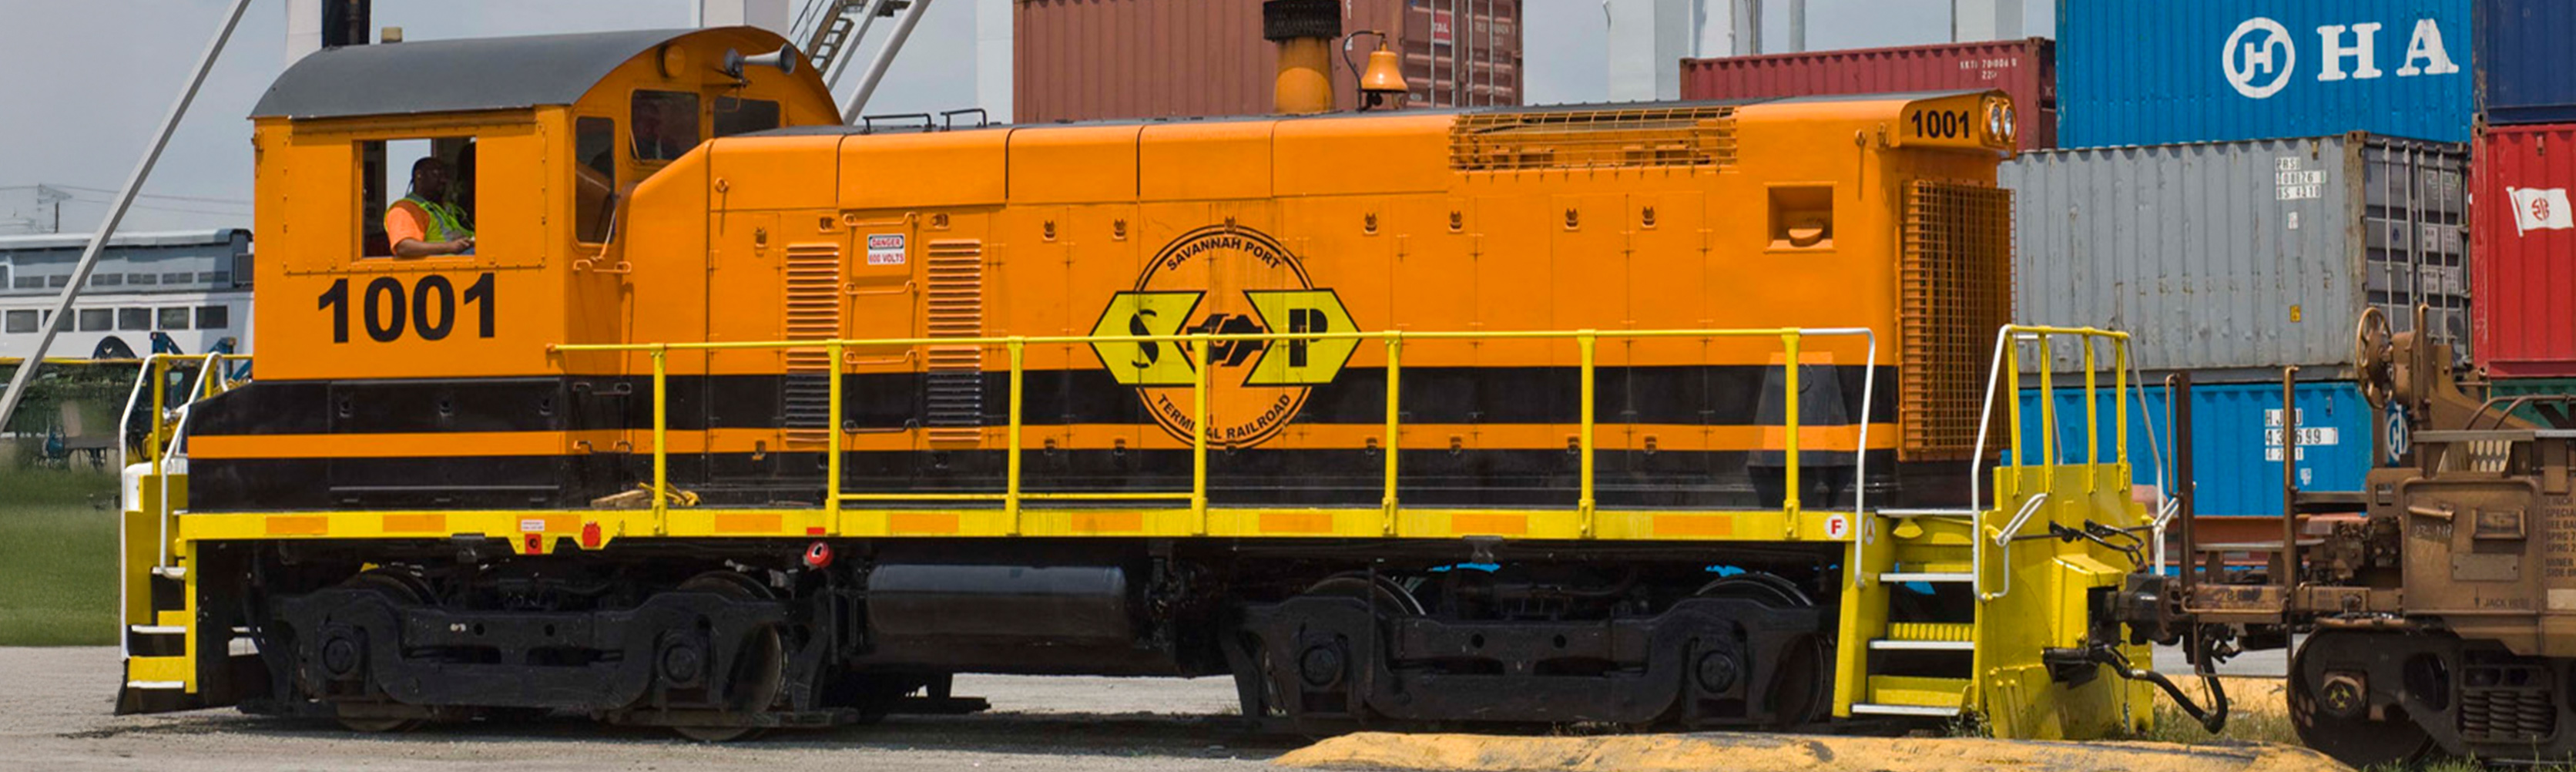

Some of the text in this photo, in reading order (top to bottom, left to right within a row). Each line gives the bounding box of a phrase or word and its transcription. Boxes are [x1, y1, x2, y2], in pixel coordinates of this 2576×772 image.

[1911, 109, 1970, 139] 1001
[871, 238, 901, 247] DANGER
[883, 253, 904, 263] VOLTS
[1166, 237, 1281, 270] SAVANNAH PORT
[318, 272, 495, 344] 1001
[1158, 394, 1290, 439] TERMIAL RAILROAD
[2266, 410, 2302, 425] HJU
[2266, 428, 2321, 445] 43699
[2267, 448, 2302, 460] 421
[1831, 519, 1842, 535] F
